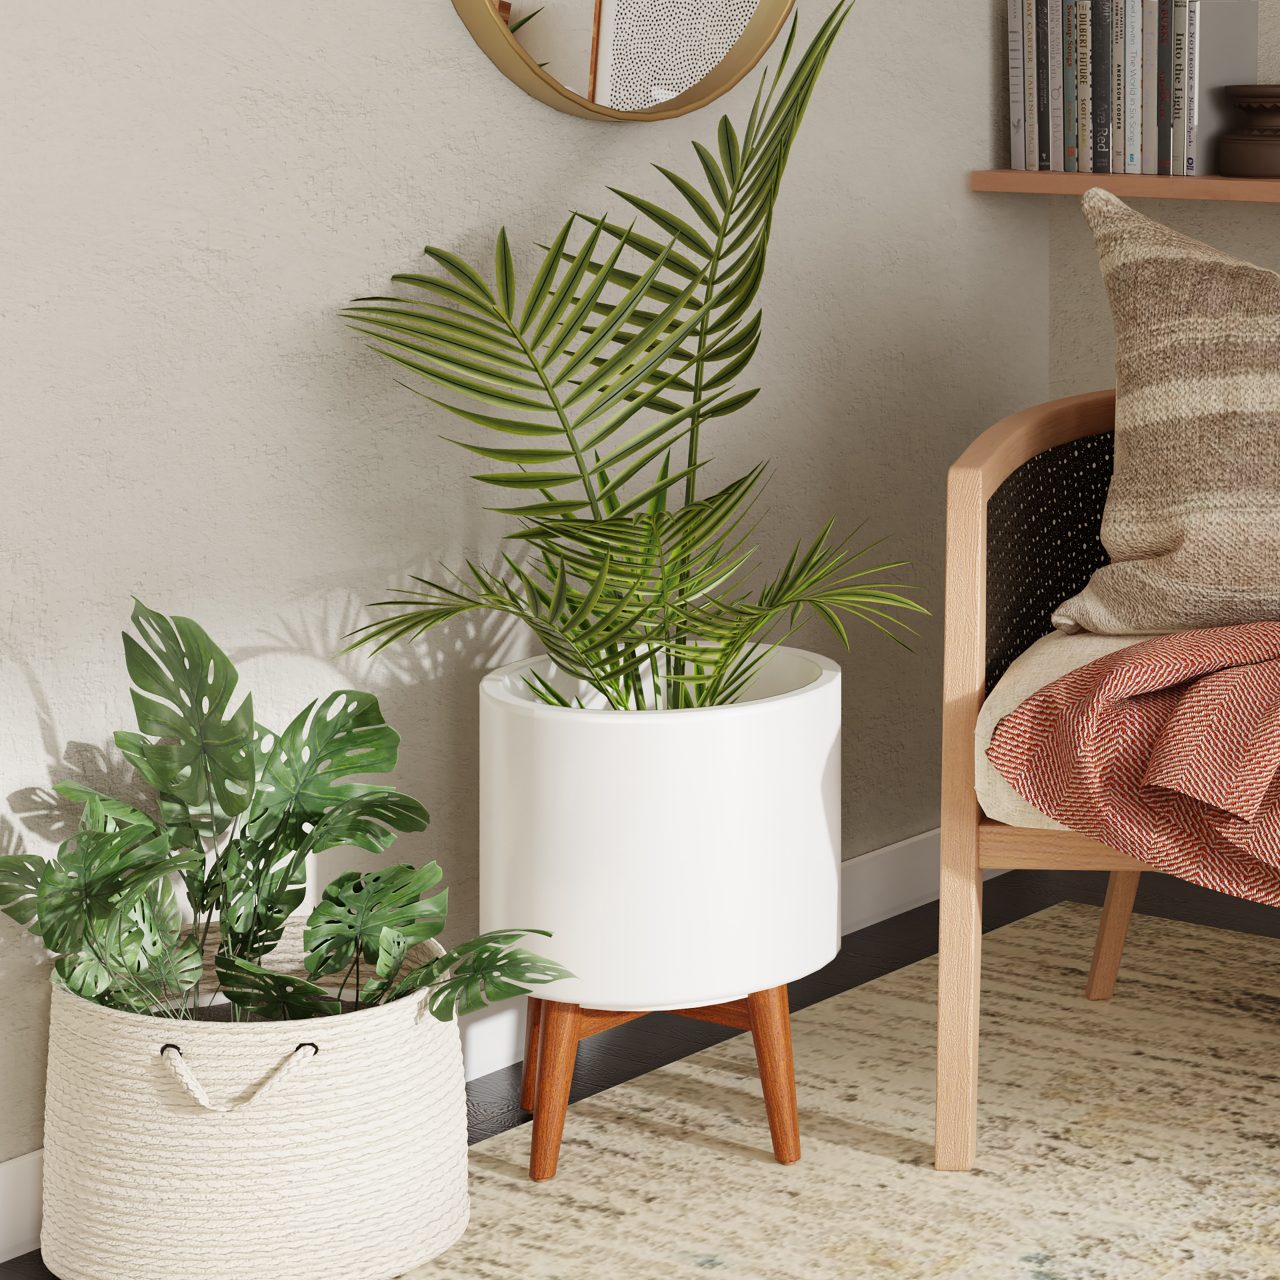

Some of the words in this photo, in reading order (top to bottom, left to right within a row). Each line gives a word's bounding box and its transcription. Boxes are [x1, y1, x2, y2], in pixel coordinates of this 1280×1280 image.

[1065, 4, 1073, 34] Swamp
[1079, 13, 1088, 49] DILBERT
[1130, 49, 1138, 67] The
[1175, 32, 1185, 60] Into
[1188, 31, 1196, 80] NOTEBOOK
[1079, 52, 1088, 86] FUTURE
[1129, 68, 1137, 96] World
[1174, 63, 1184, 84] the
[1172, 87, 1183, 120] Light
[1097, 127, 1109, 152] Red
